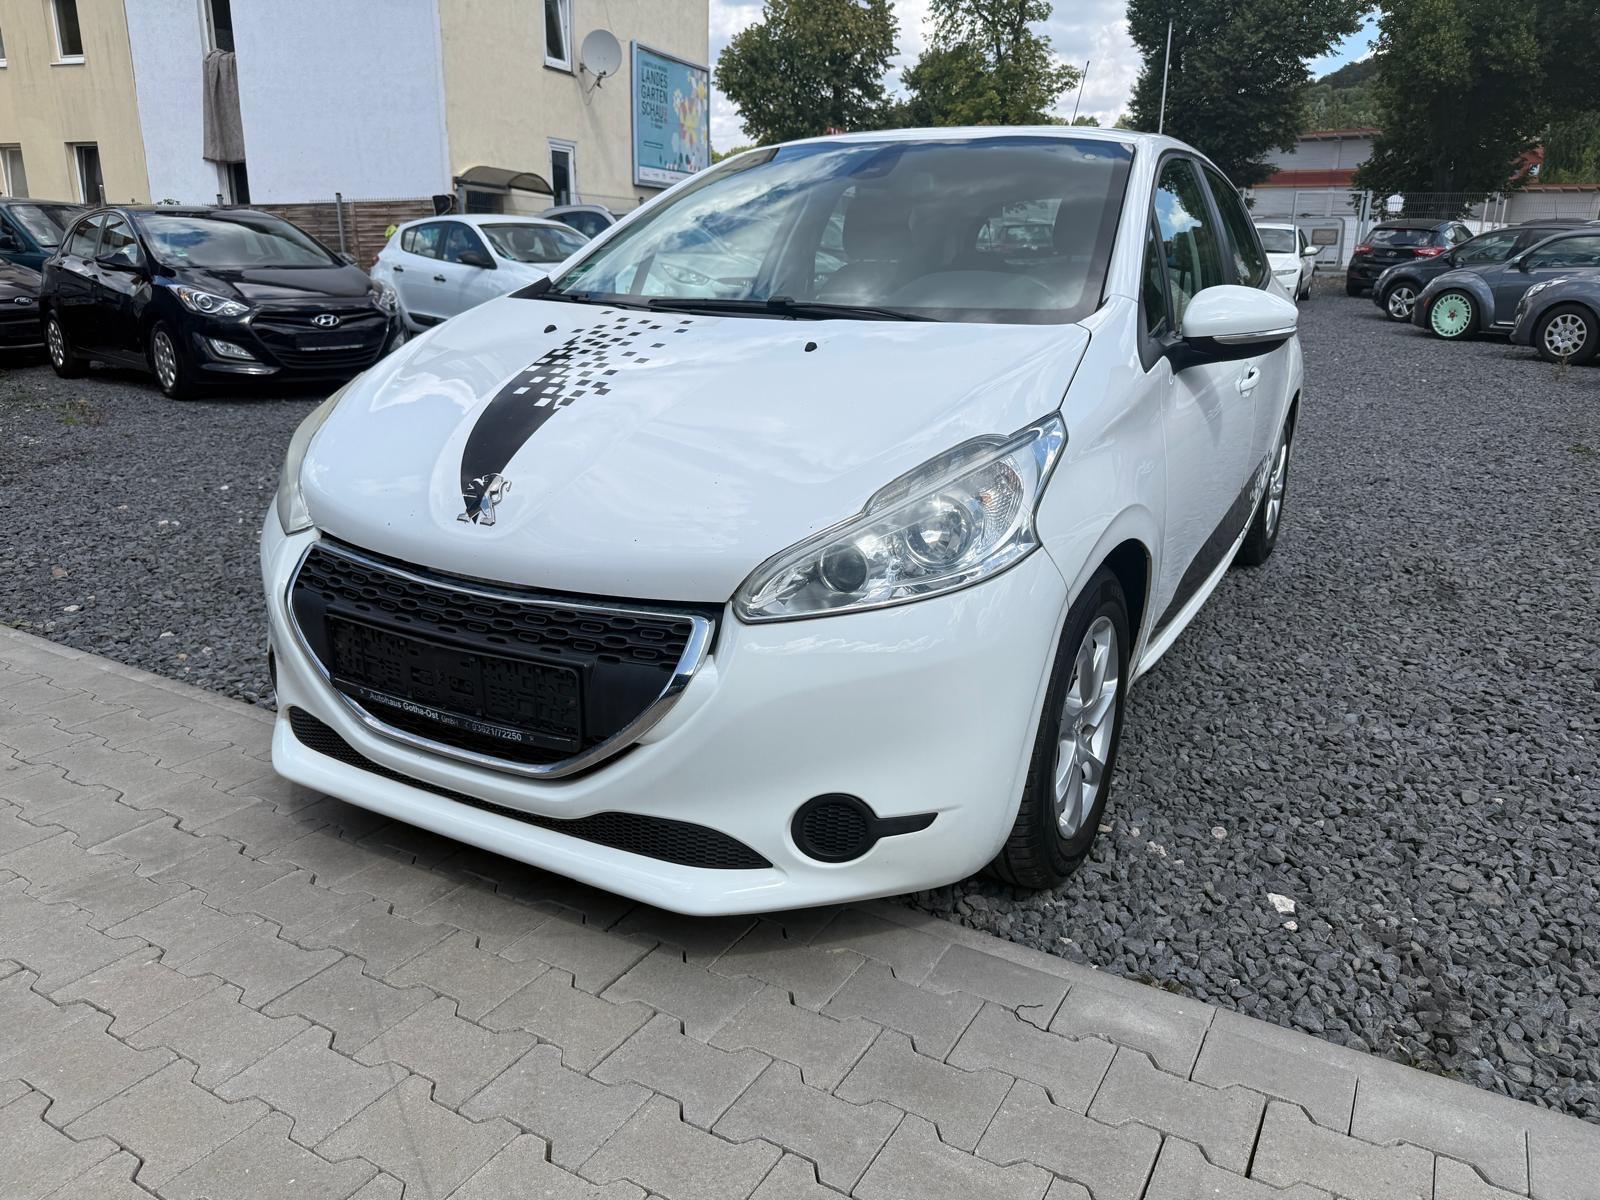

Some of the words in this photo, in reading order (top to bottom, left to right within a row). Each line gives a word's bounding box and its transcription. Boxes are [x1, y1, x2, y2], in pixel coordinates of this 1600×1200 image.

[641, 67, 668, 89] LANDES
[641, 85, 668, 104] GARTEN
[369, 692, 402, 708] Autohaus
[402, 702, 439, 720] Gotha-Ost
[471, 723, 522, 740] 03621/72250
